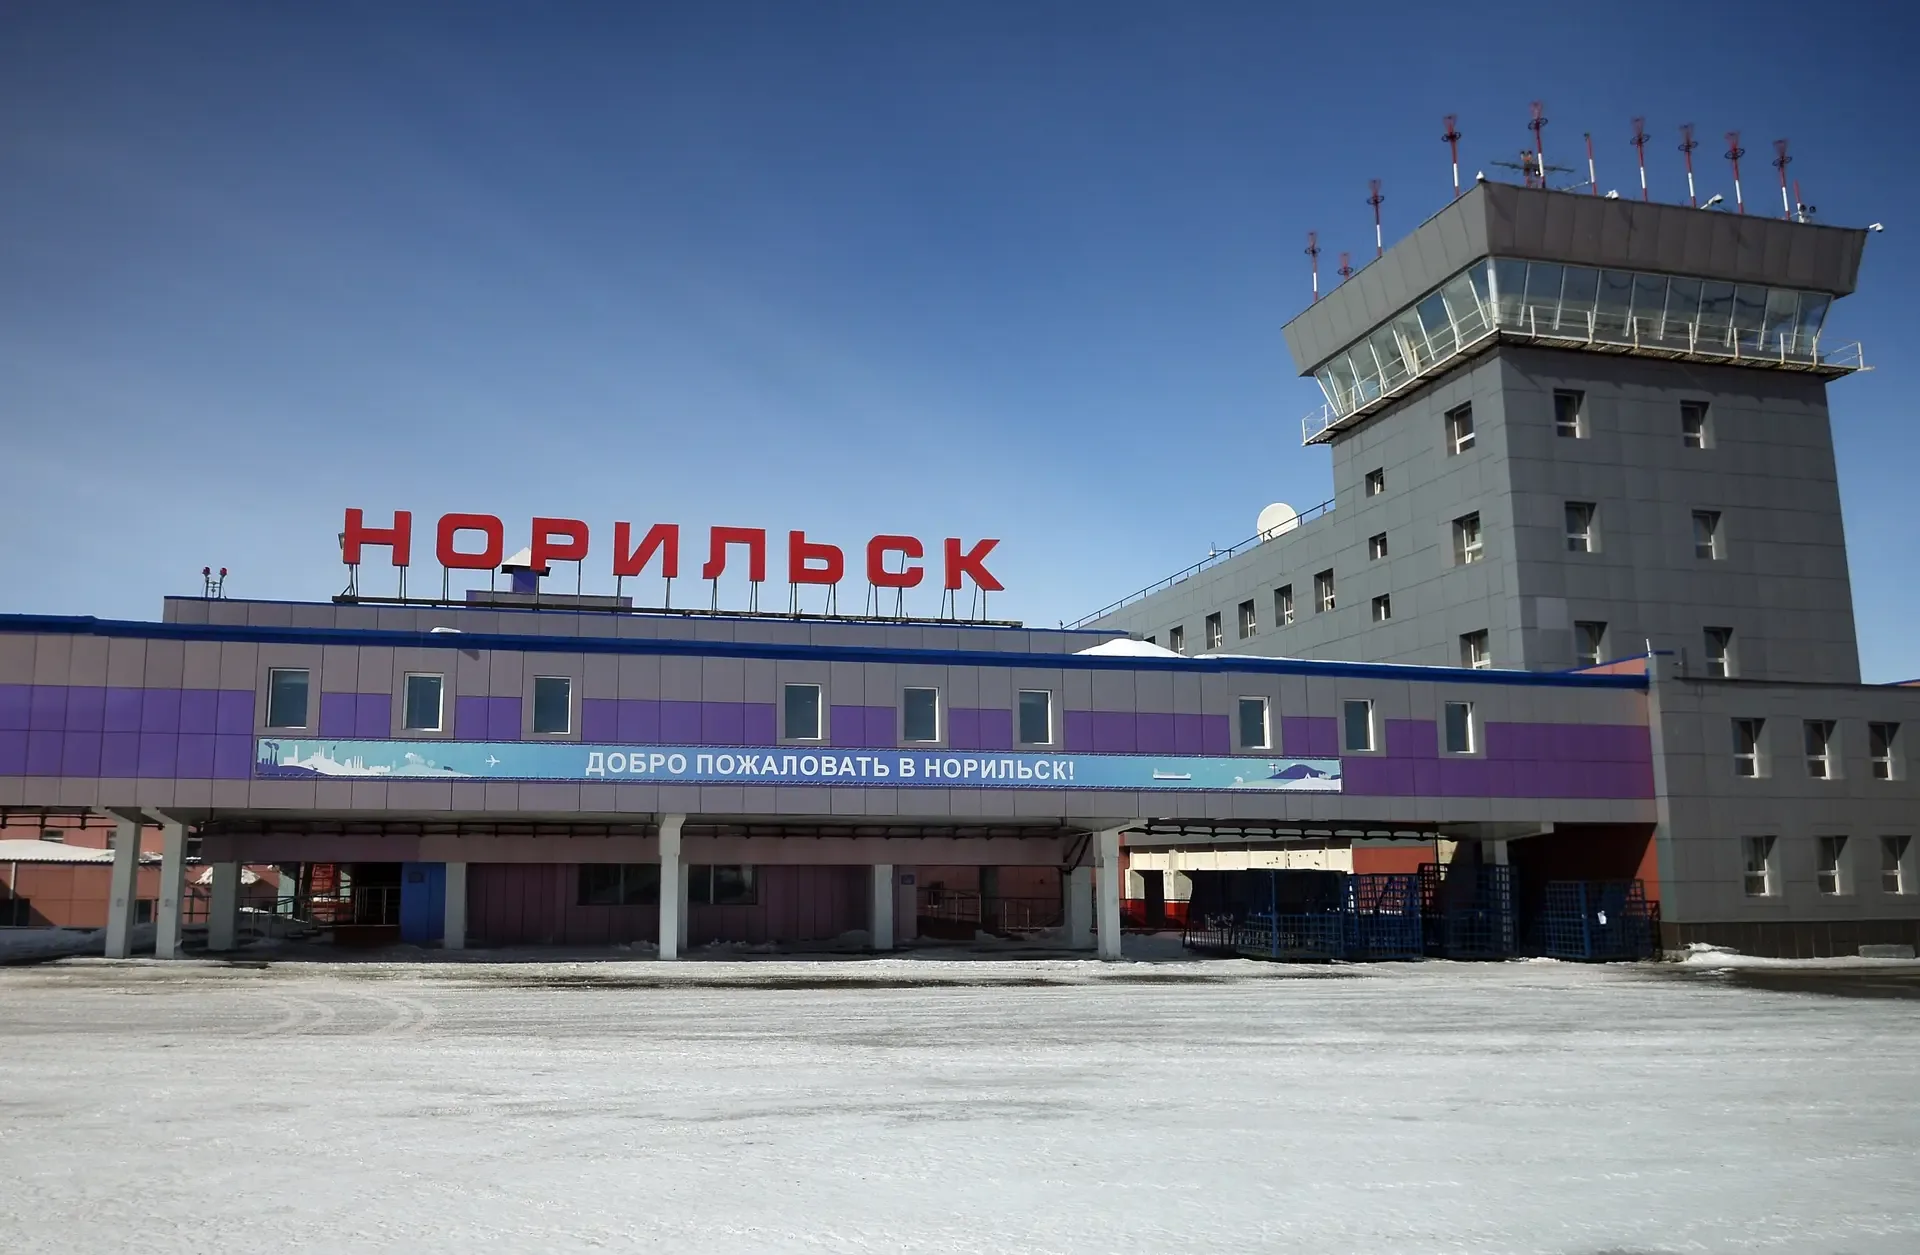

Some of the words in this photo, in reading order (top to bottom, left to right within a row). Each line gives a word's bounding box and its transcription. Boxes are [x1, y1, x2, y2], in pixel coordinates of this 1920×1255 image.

[343, 508, 1003, 591] НОРИЛЬСК
[585, 752, 687, 777] ДОБРО
[696, 754, 891, 778] ПОЖАЛОВАТЬ
[899, 757, 916, 778] В
[925, 758, 1075, 781] НОРИЛЬСК!
